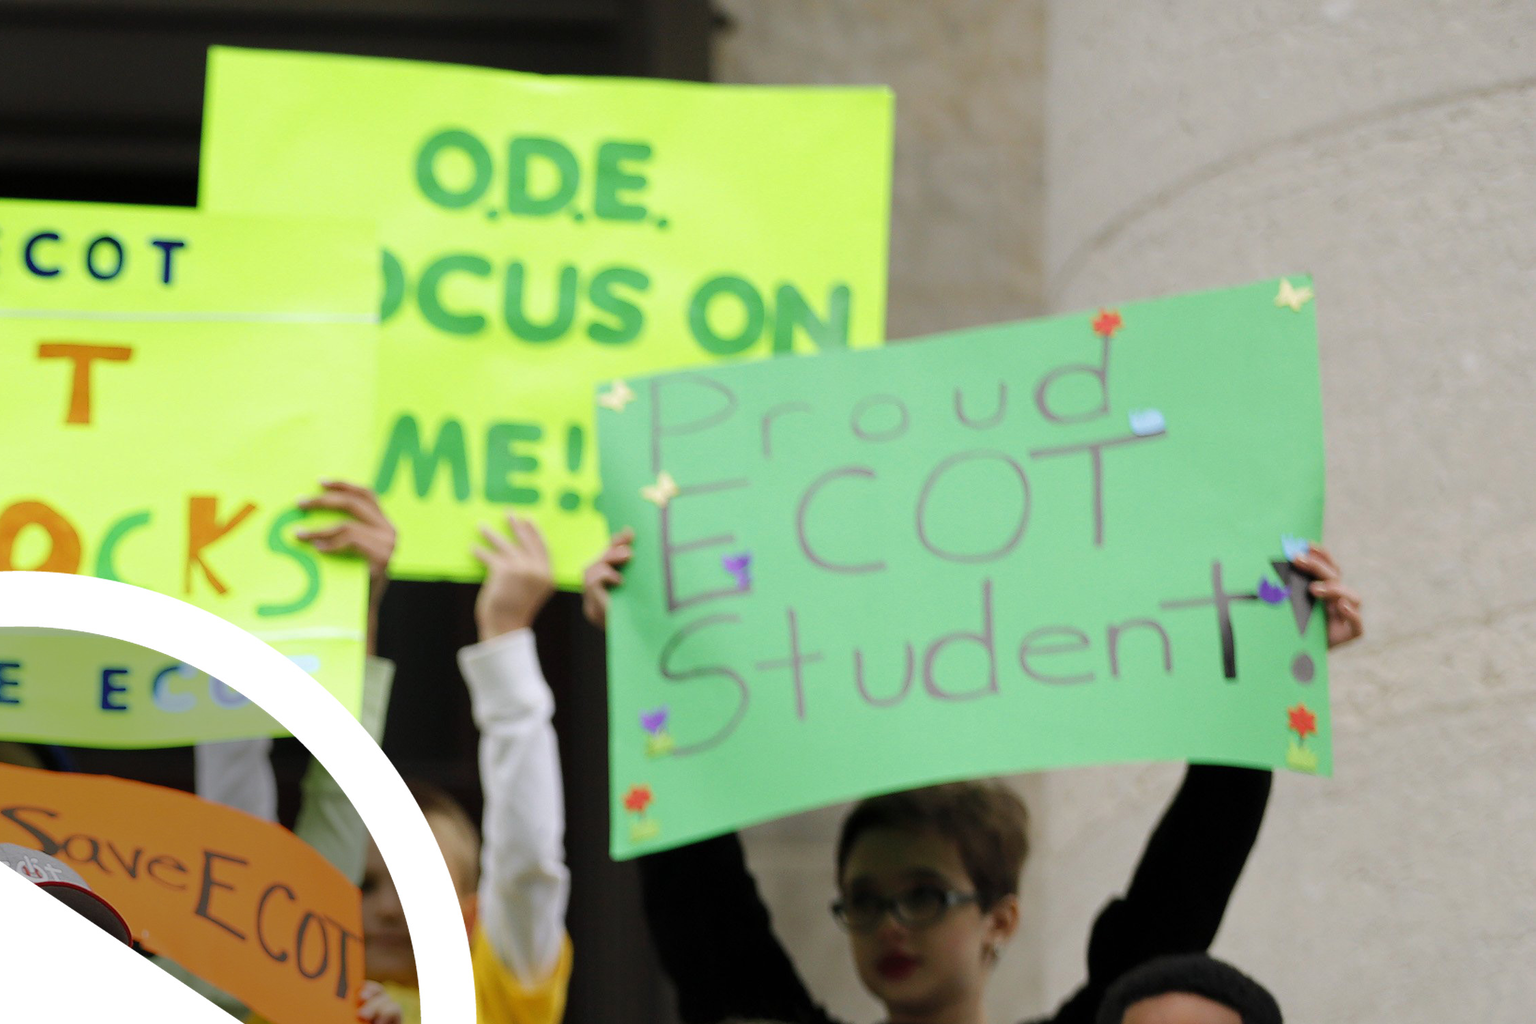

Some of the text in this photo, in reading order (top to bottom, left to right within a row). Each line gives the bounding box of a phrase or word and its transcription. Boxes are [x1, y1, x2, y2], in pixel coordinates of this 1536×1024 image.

[413, 127, 670, 230] O.D.E.
[381, 247, 853, 357] CUS ON
[373, 414, 603, 512] ME!
[648, 330, 1114, 474] Proud
[657, 428, 1168, 614] ECOT
[657, 558, 1317, 758] Student!
